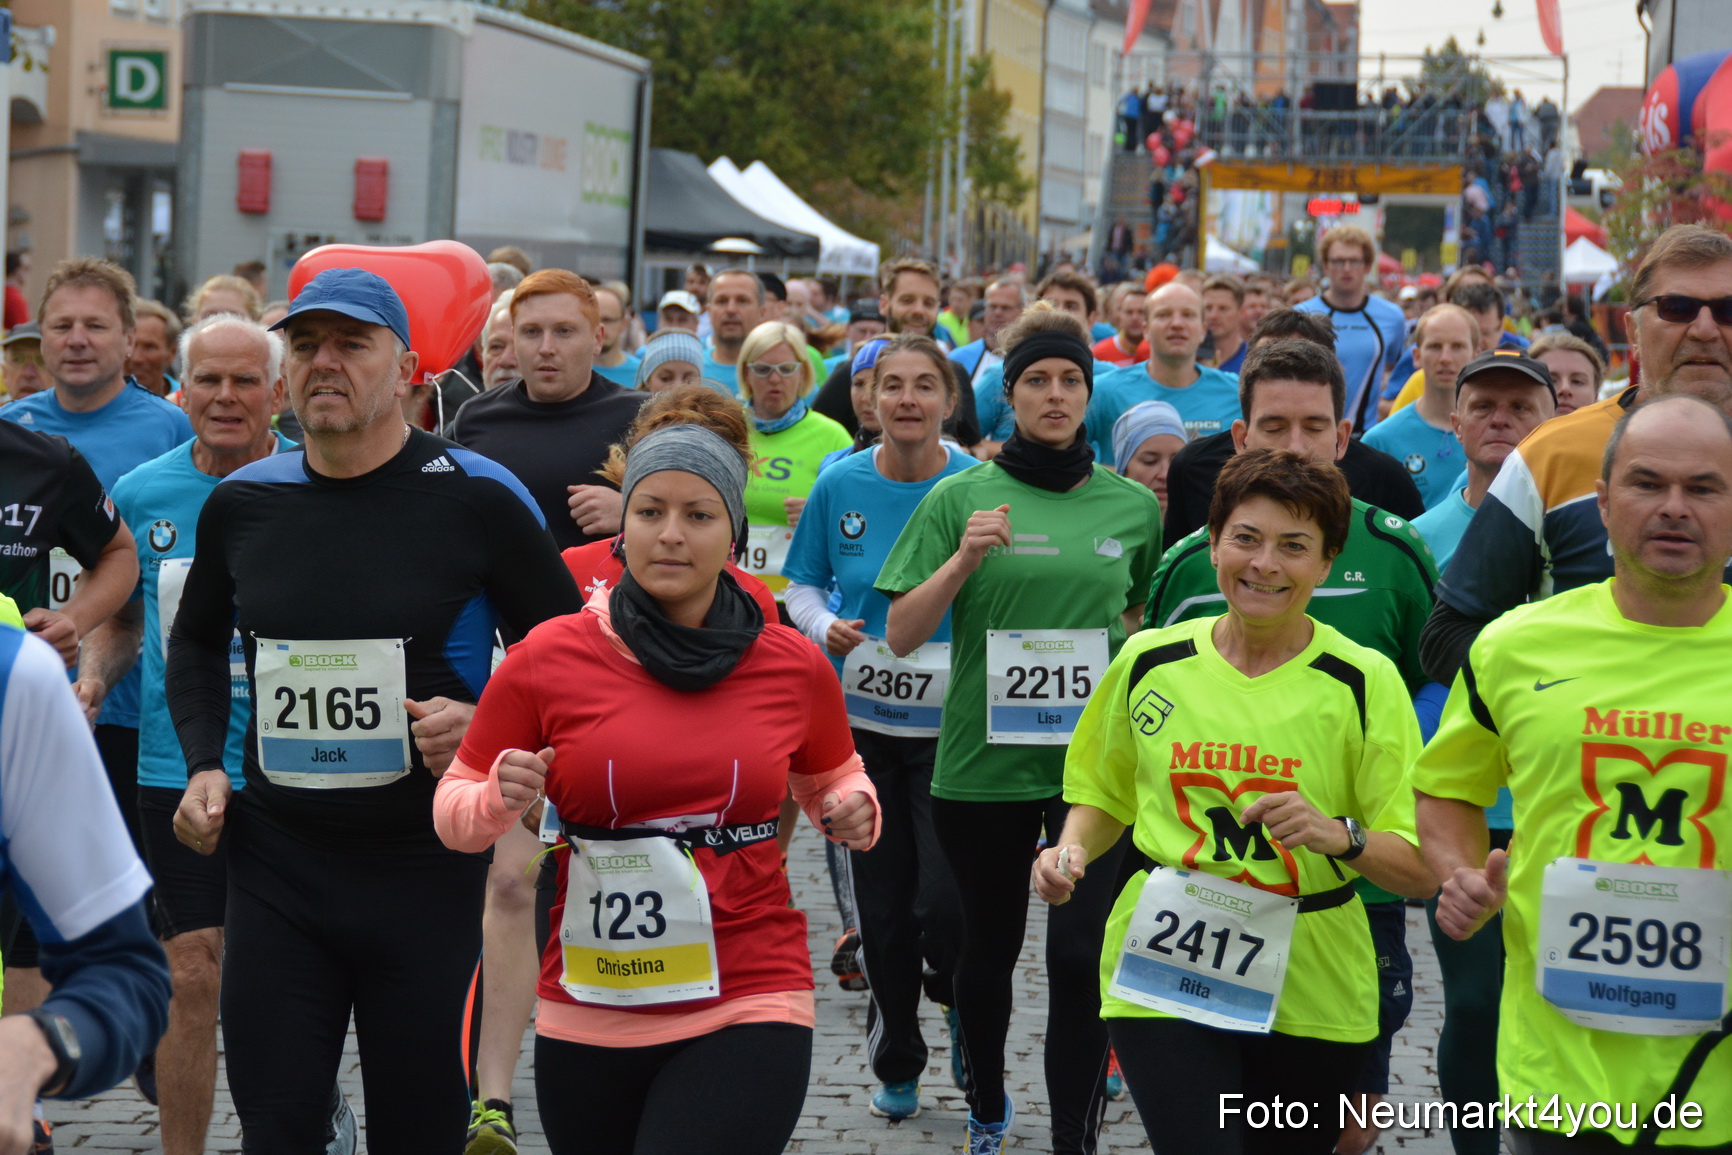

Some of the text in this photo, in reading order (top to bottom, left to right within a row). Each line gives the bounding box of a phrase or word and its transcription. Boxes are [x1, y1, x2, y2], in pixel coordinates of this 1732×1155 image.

[116, 56, 161, 103] D
[839, 542, 864, 551] PARTL
[1344, 571, 1365, 582] C.R.
[1034, 640, 1074, 650] BOCK
[304, 654, 358, 667] BOCK
[857, 664, 933, 701] 2367
[1006, 666, 1092, 699] 2215
[275, 686, 382, 731] 2165
[873, 705, 909, 720] Sabine
[1037, 711, 1063, 726] Lisa
[1584, 706, 1732, 745] Müller
[311, 747, 348, 763] Jack
[1169, 741, 1302, 778] Müller
[1609, 781, 1689, 847] M
[1204, 806, 1278, 862] M
[596, 854, 651, 869] BOCK
[1199, 887, 1253, 914] BOCK
[1614, 879, 1679, 898] BOCK
[589, 891, 667, 940] 123
[1146, 910, 1265, 977] 2417
[1567, 912, 1703, 971] 2598
[596, 957, 665, 977] Christina
[1178, 976, 1211, 999] Rita
[1588, 981, 1677, 1011] Wolfgang
